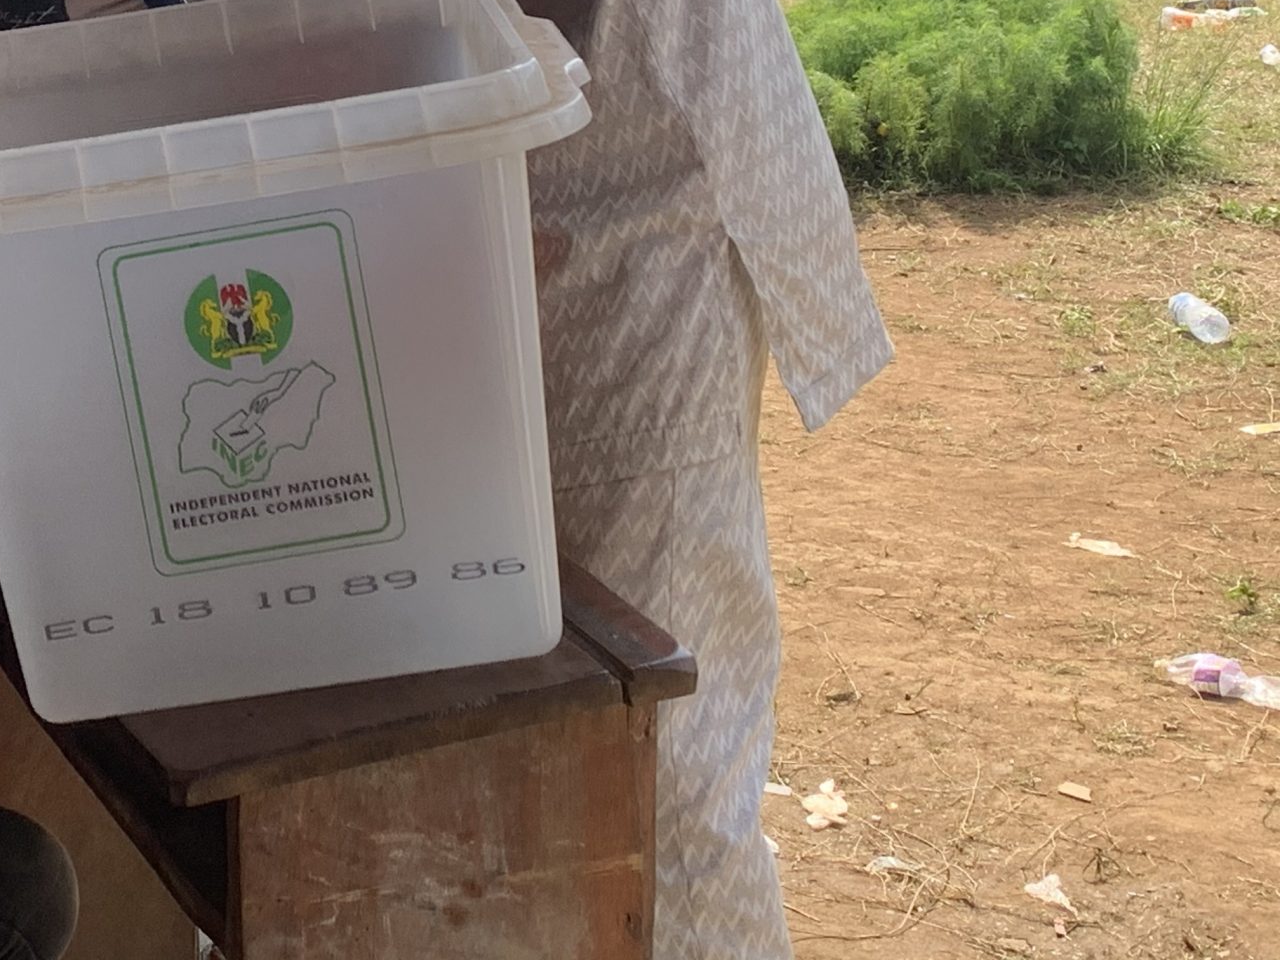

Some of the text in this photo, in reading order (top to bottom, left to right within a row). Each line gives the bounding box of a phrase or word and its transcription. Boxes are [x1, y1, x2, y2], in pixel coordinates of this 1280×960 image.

[211, 437, 268, 477] INEC
[169, 472, 371, 514] INDEPENDENT NATIONAL
[172, 488, 375, 531] ELECTORAL COMMISSION
[44, 556, 528, 641] EC 18 10 89 86
